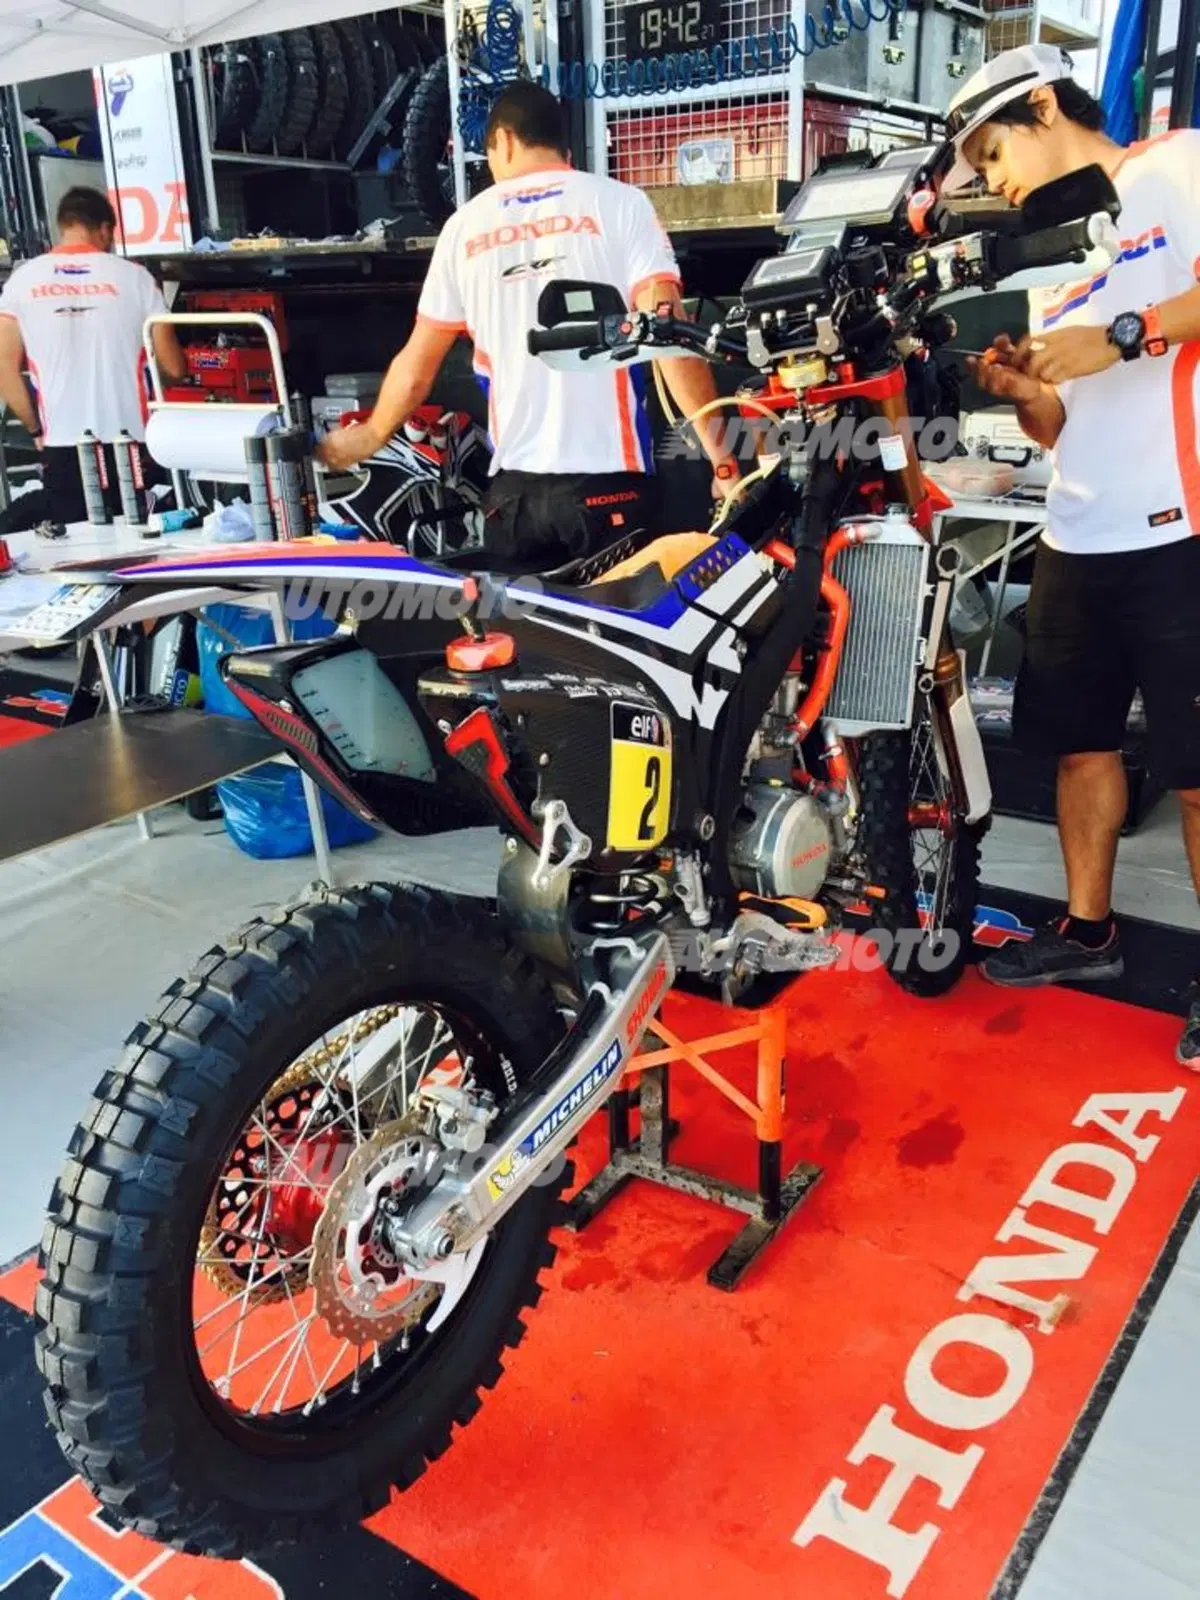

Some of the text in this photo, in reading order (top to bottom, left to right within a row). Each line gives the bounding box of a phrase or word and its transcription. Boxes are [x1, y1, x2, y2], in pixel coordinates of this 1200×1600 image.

[640, 1, 701, 49] 19:42
[464, 215, 601, 259] HONDA
[31, 284, 119, 298] HONDA
[585, 491, 639, 506] HONDA
[631, 715, 652, 738] elf
[637, 756, 660, 840] 2
[532, 1044, 620, 1150] MICHELIN
[790, 1086, 1187, 1600] HONDA
